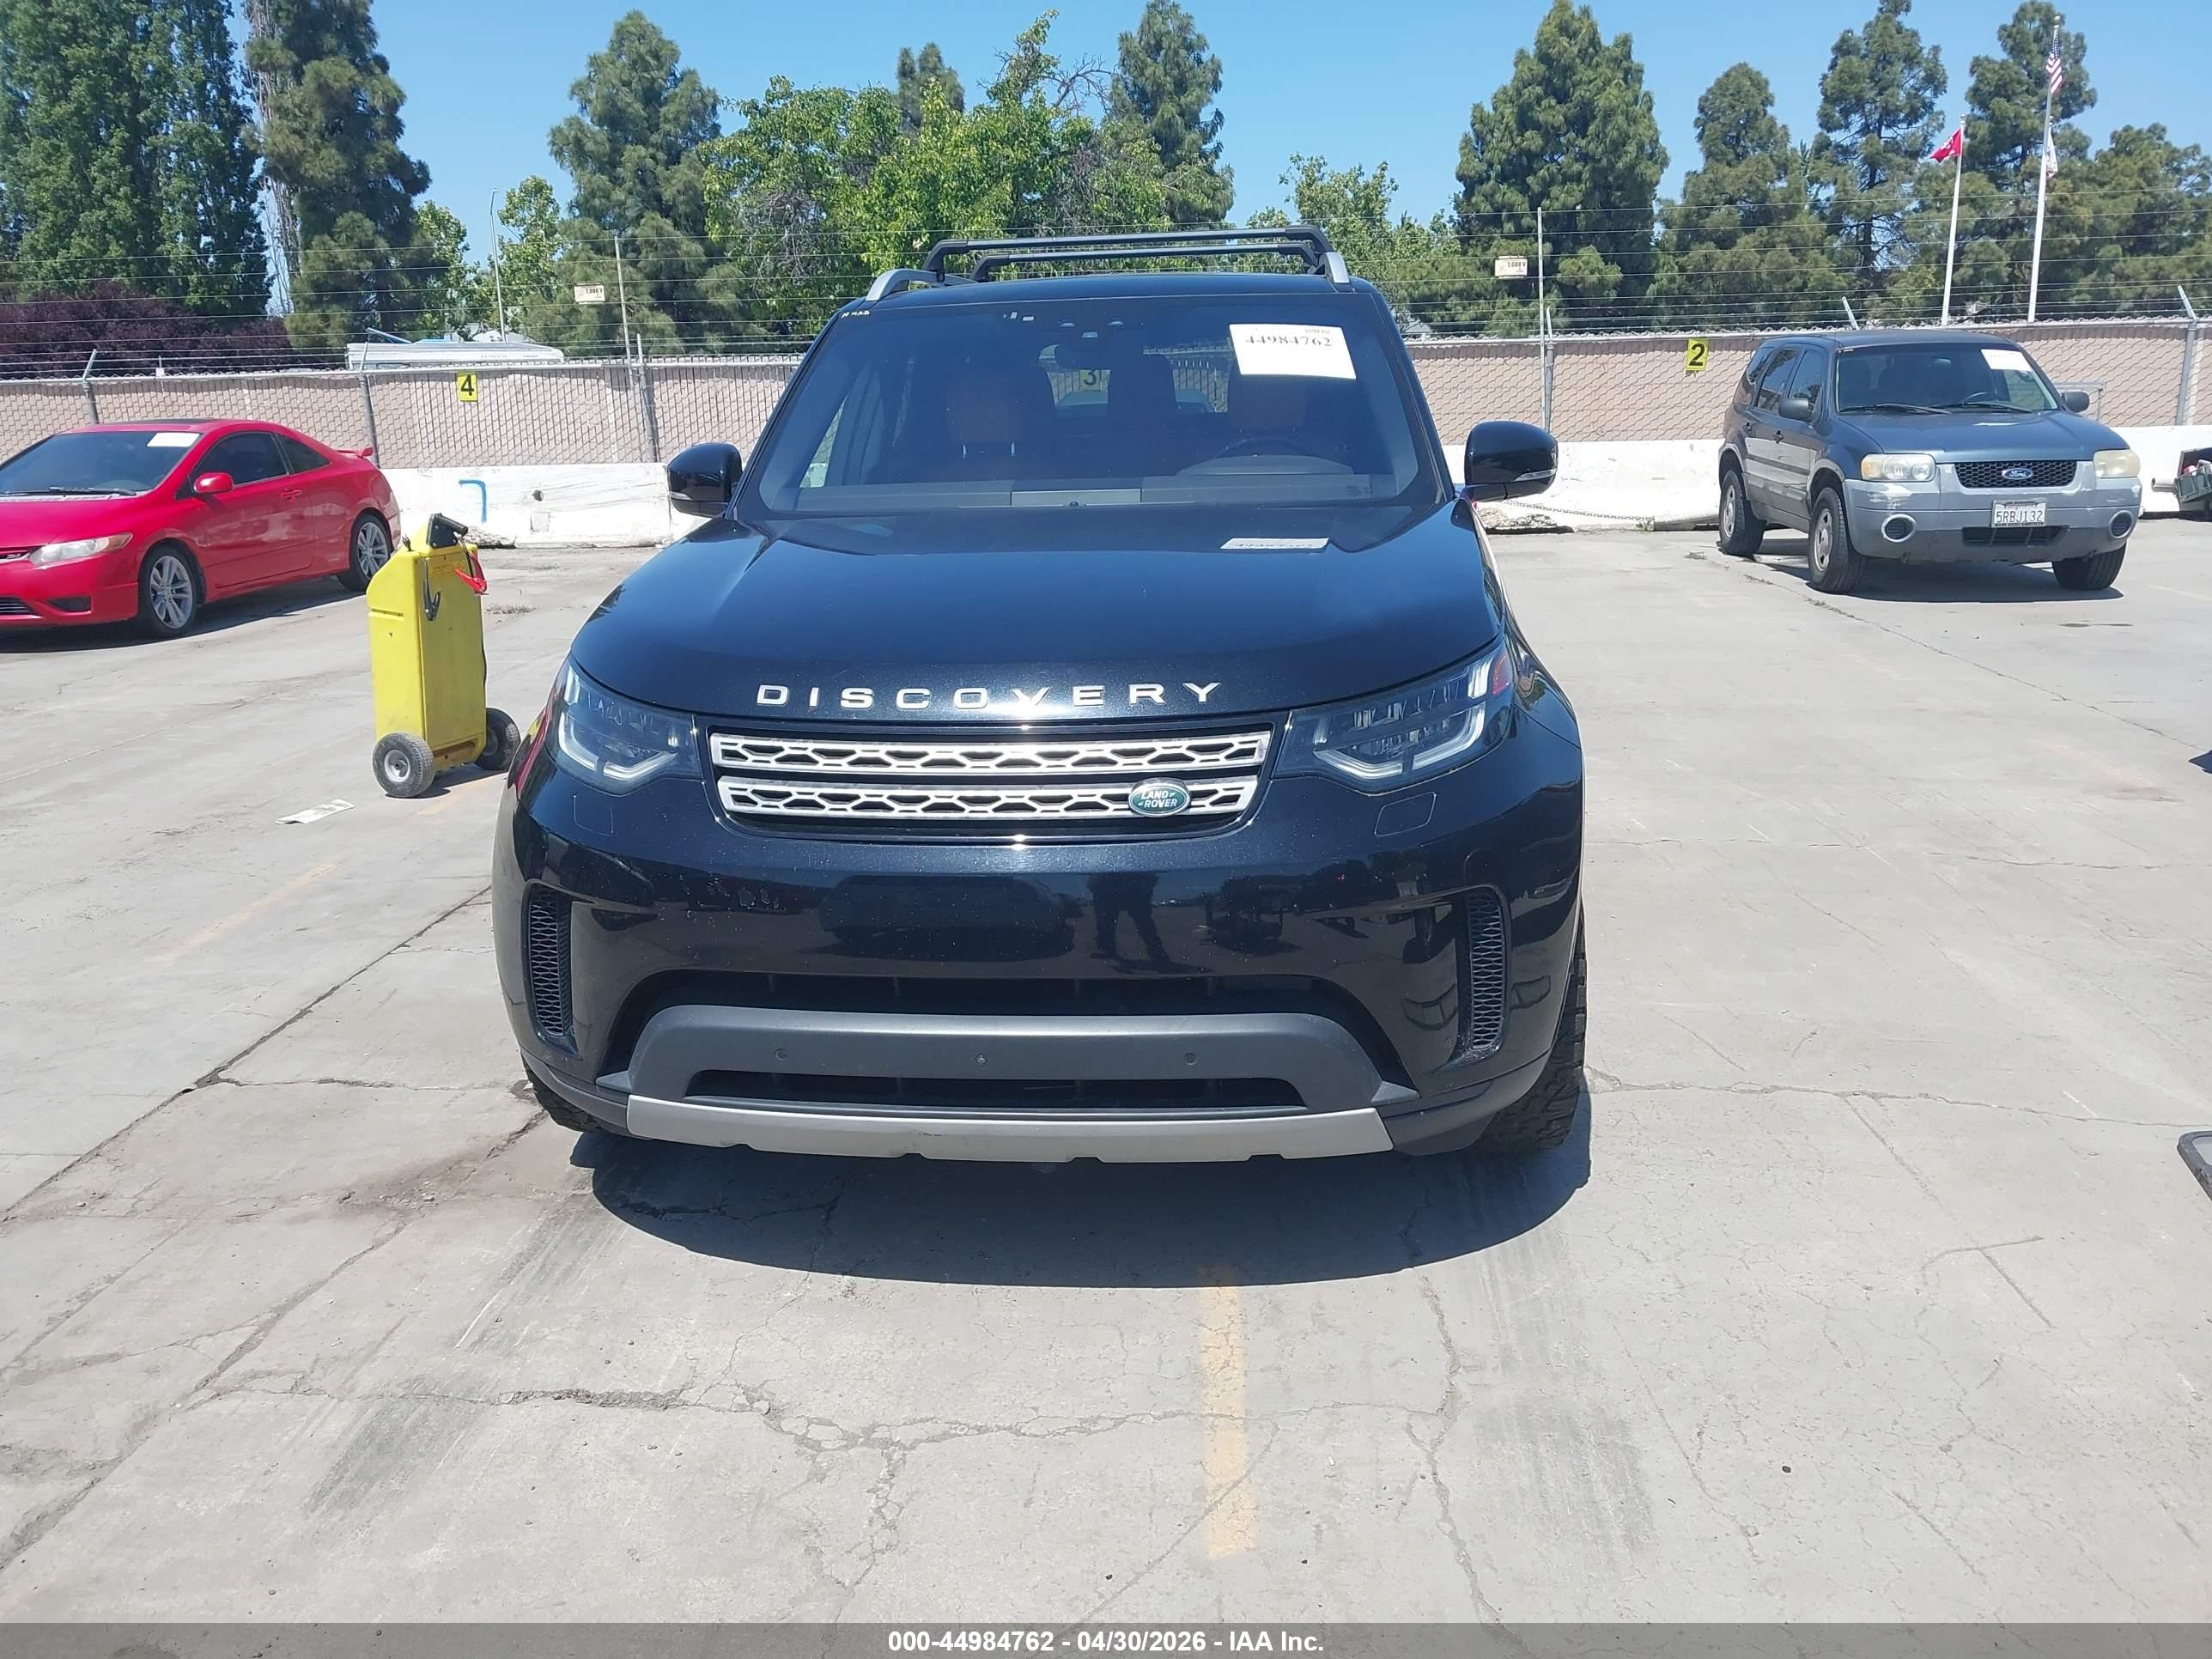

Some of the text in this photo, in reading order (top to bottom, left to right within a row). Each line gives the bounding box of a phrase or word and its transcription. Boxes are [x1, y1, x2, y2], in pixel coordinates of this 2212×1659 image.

[1245, 335, 1332, 346] 44984762
[1688, 343, 1705, 367] 2
[1084, 369, 1097, 386] 3
[460, 374, 475, 397] 4
[1996, 510, 2043, 523] 5RBJ132
[756, 682, 1223, 709] DISCOVERY
[1140, 790, 1169, 800] LAND
[1144, 798, 1178, 808] ROVER
